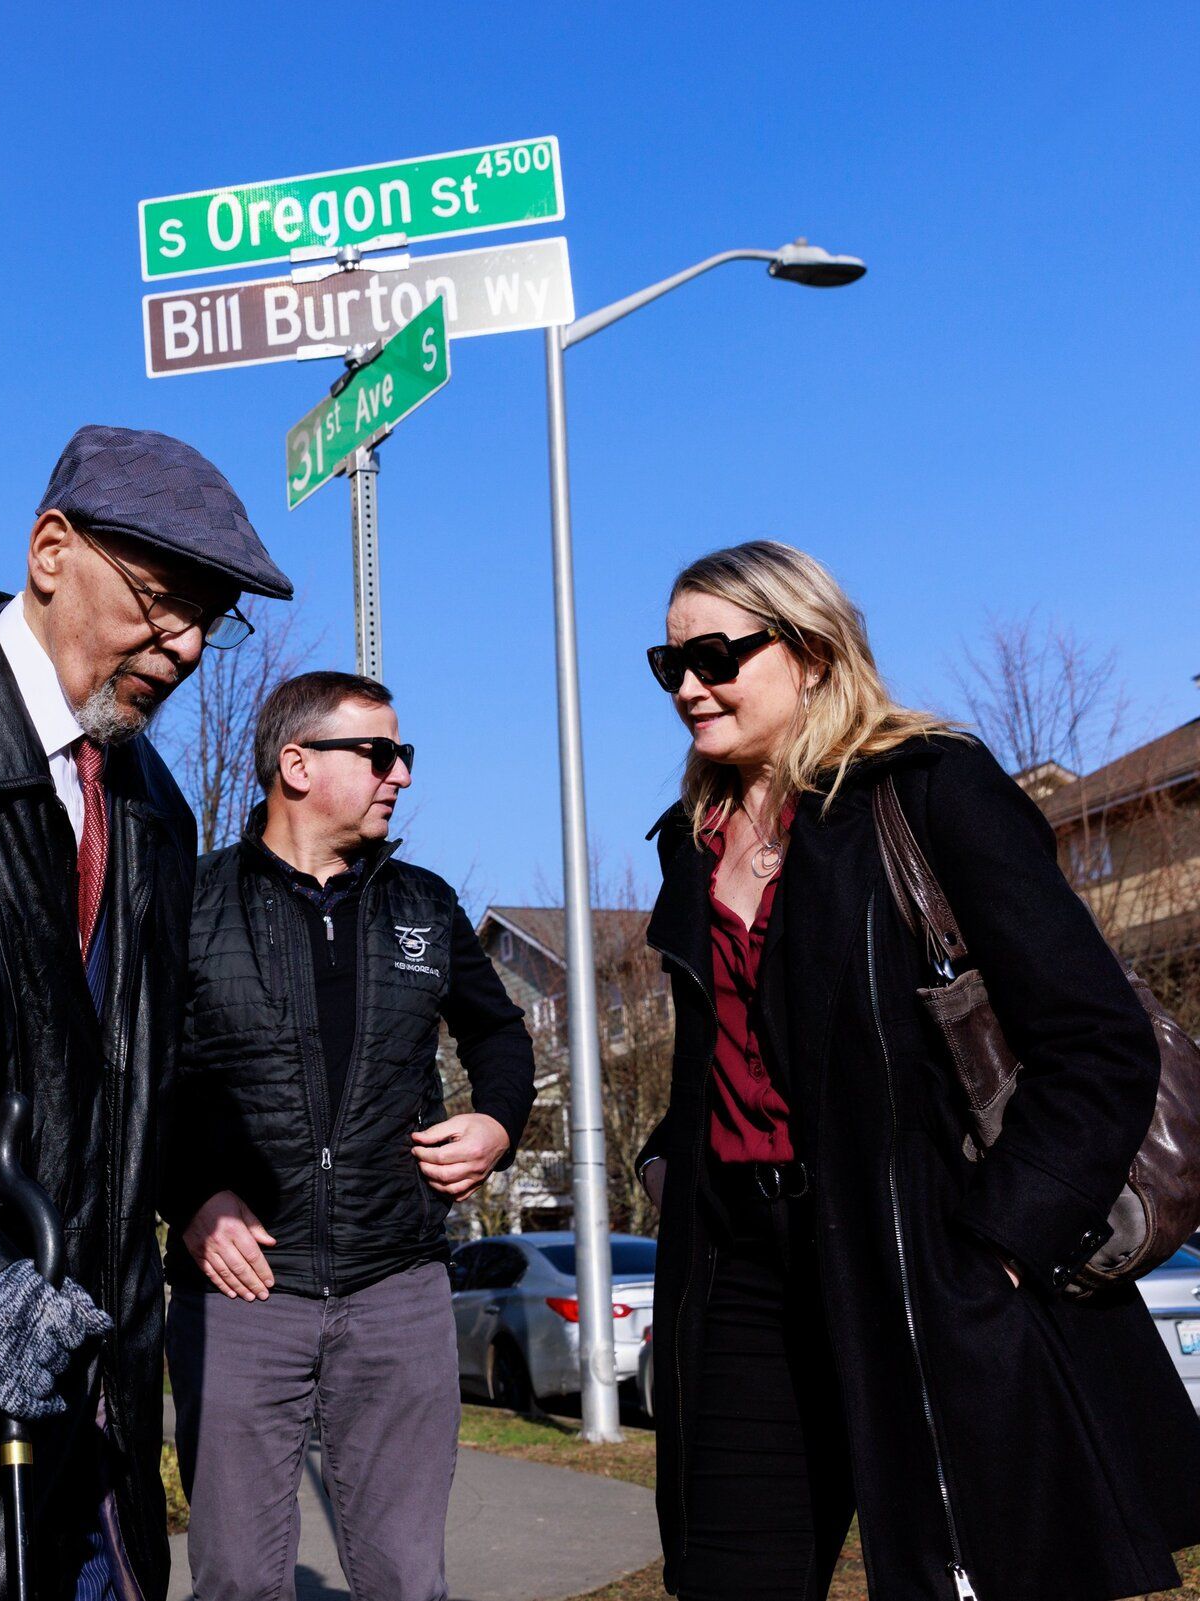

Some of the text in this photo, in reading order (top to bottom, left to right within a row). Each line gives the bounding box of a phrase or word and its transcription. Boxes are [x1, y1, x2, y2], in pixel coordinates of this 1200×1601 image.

[159, 143, 551, 259] S Oregon St 4500
[163, 272, 550, 360] Bill Burton Wy
[292, 327, 438, 491] 31st Ave S
